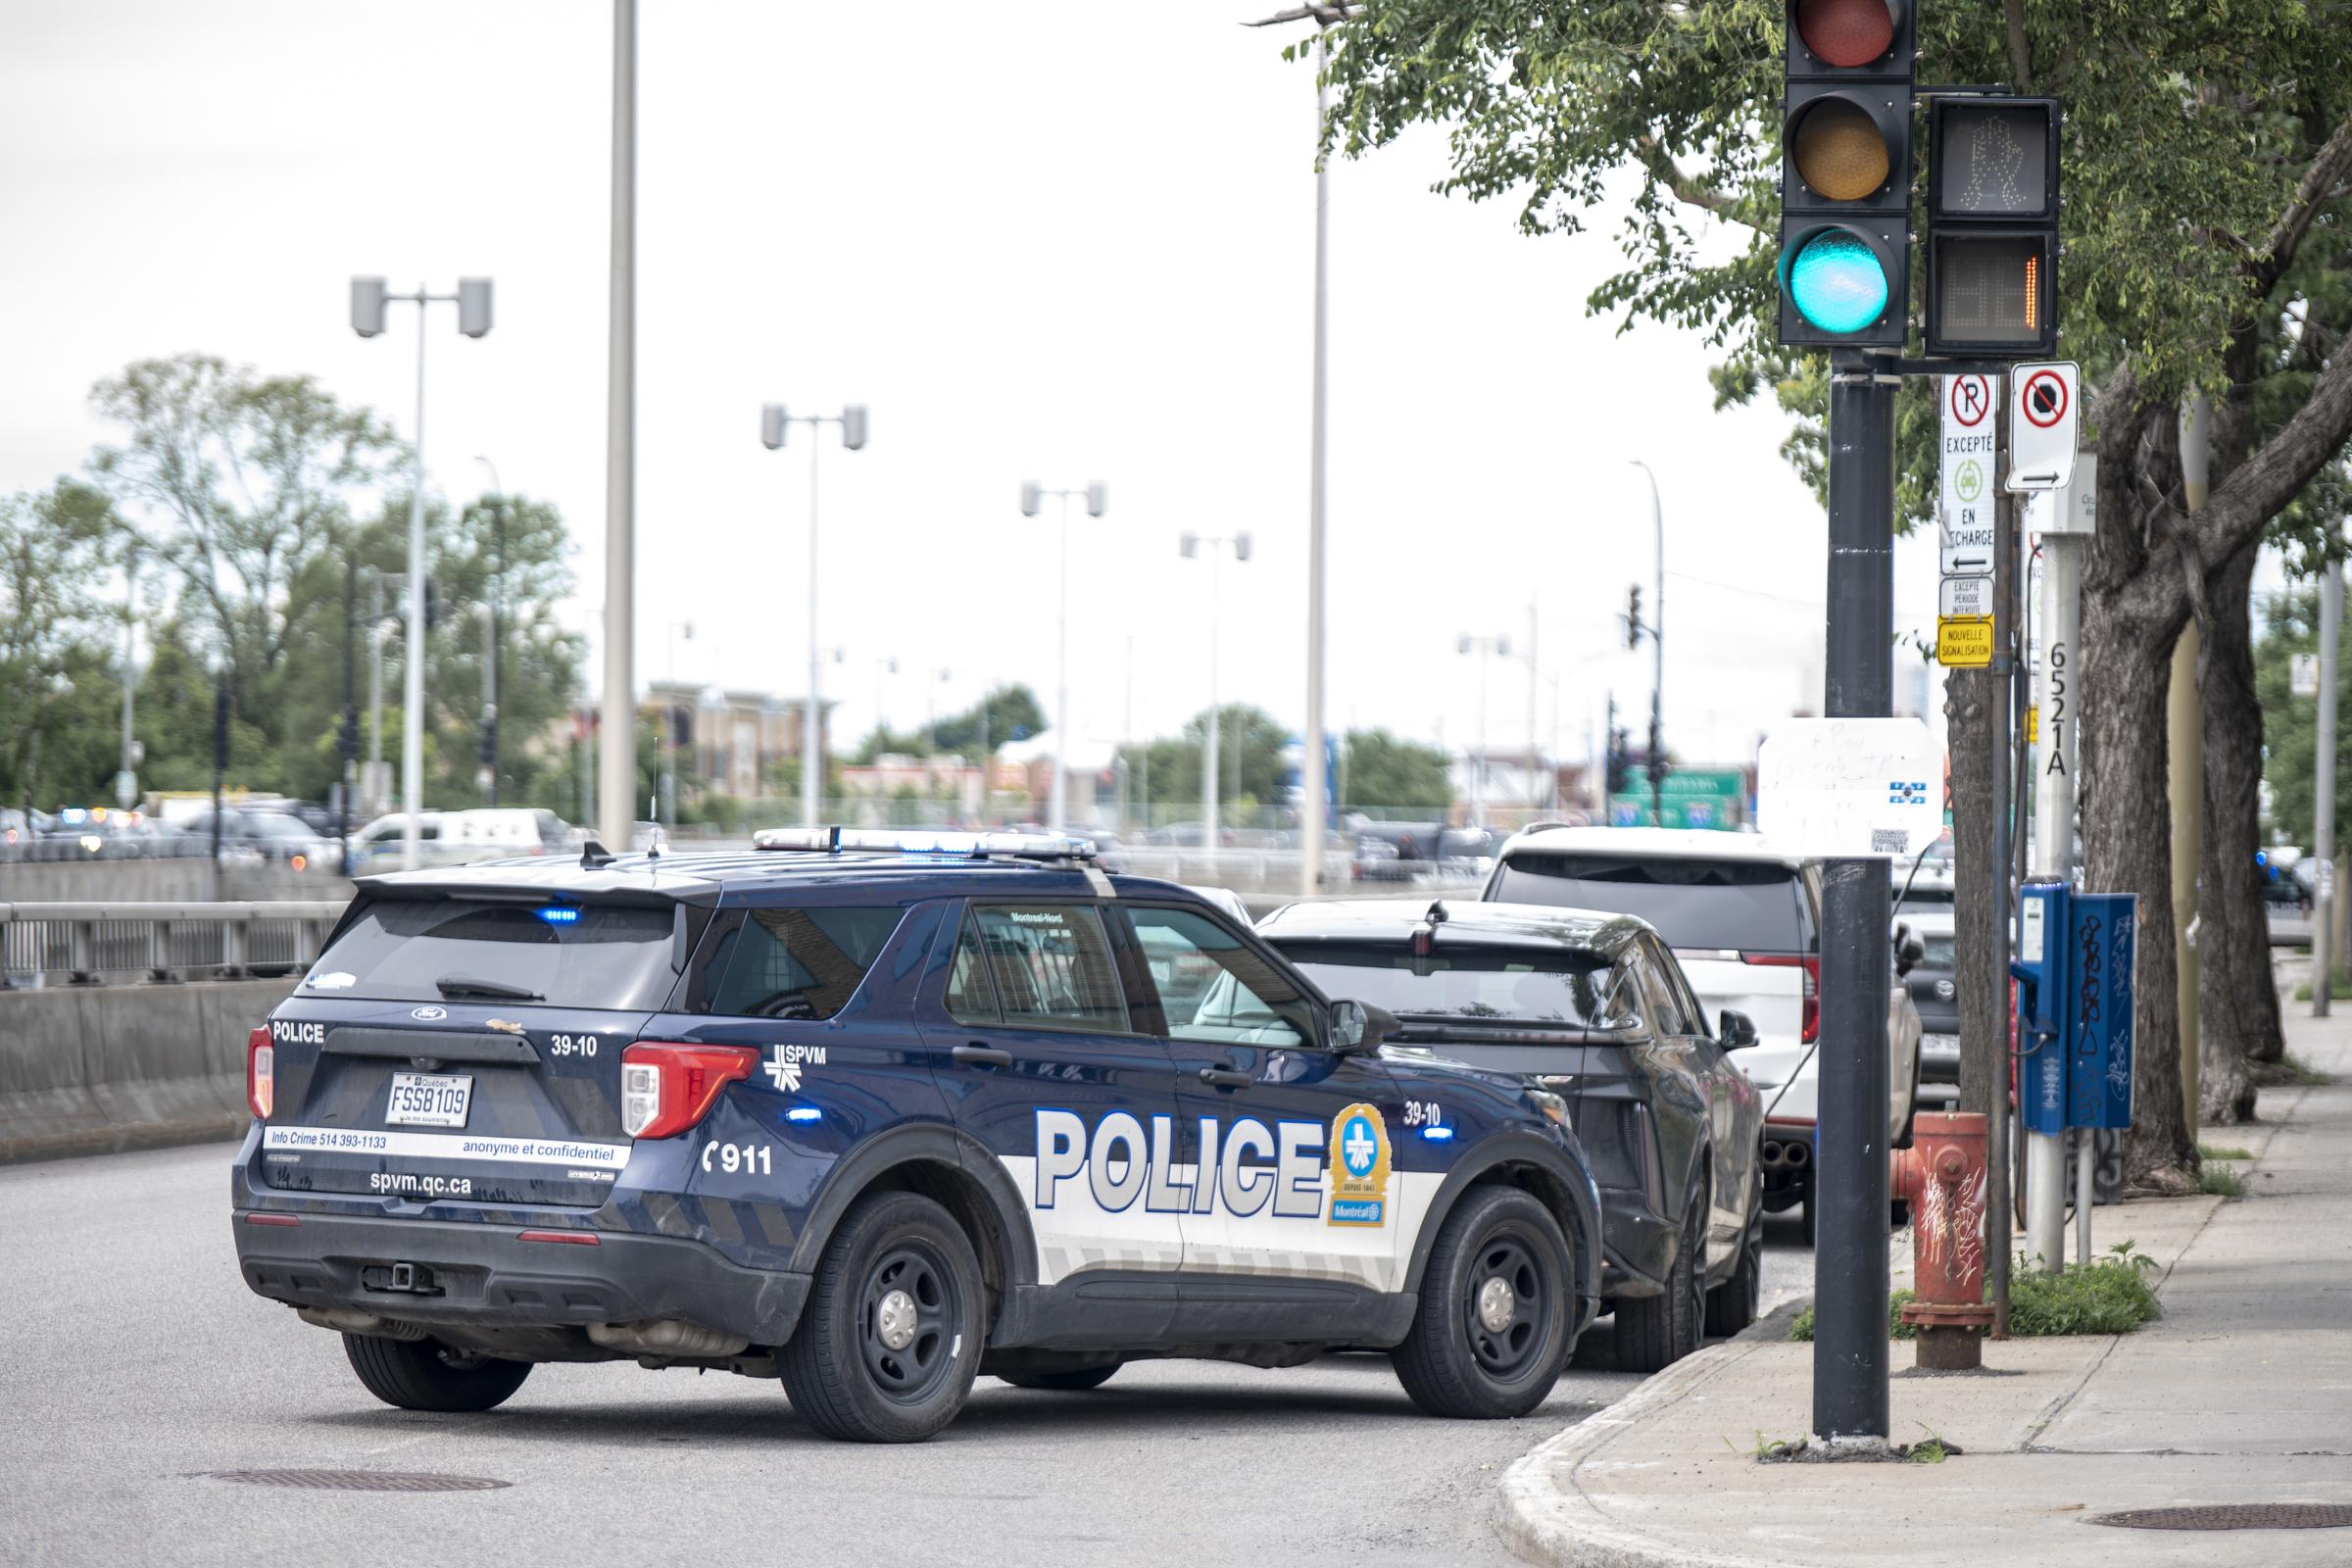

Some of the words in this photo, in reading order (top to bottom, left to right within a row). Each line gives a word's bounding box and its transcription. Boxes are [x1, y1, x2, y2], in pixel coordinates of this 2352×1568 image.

[1946, 432, 1992, 453] EXCEPTÉ
[1962, 509, 1976, 524] EN
[1949, 530, 1993, 546] ECHARGE
[1947, 629, 1983, 641] NOUVELLE
[1941, 645, 1989, 657] SIGNALISATION
[273, 1021, 324, 1043] POLICE
[551, 1034, 598, 1056] 39-10
[786, 1045, 826, 1064] SPVM
[421, 1078, 448, 1087] Québec
[392, 1086, 466, 1113] FSS8109
[1403, 1101, 1441, 1126] 39-10
[271, 1131, 288, 1144] Info
[290, 1131, 318, 1145] Crime
[319, 1133, 337, 1146] 514
[339, 1134, 387, 1149] 393-1133
[463, 1142, 519, 1156] anonyme
[522, 1143, 534, 1154] et
[537, 1145, 614, 1160] confidentiel
[721, 1143, 771, 1174] 911
[1034, 1106, 1325, 1218] POLICE
[370, 1172, 471, 1197] spvm.qc.ca
[1335, 1204, 1370, 1216] Montréal
